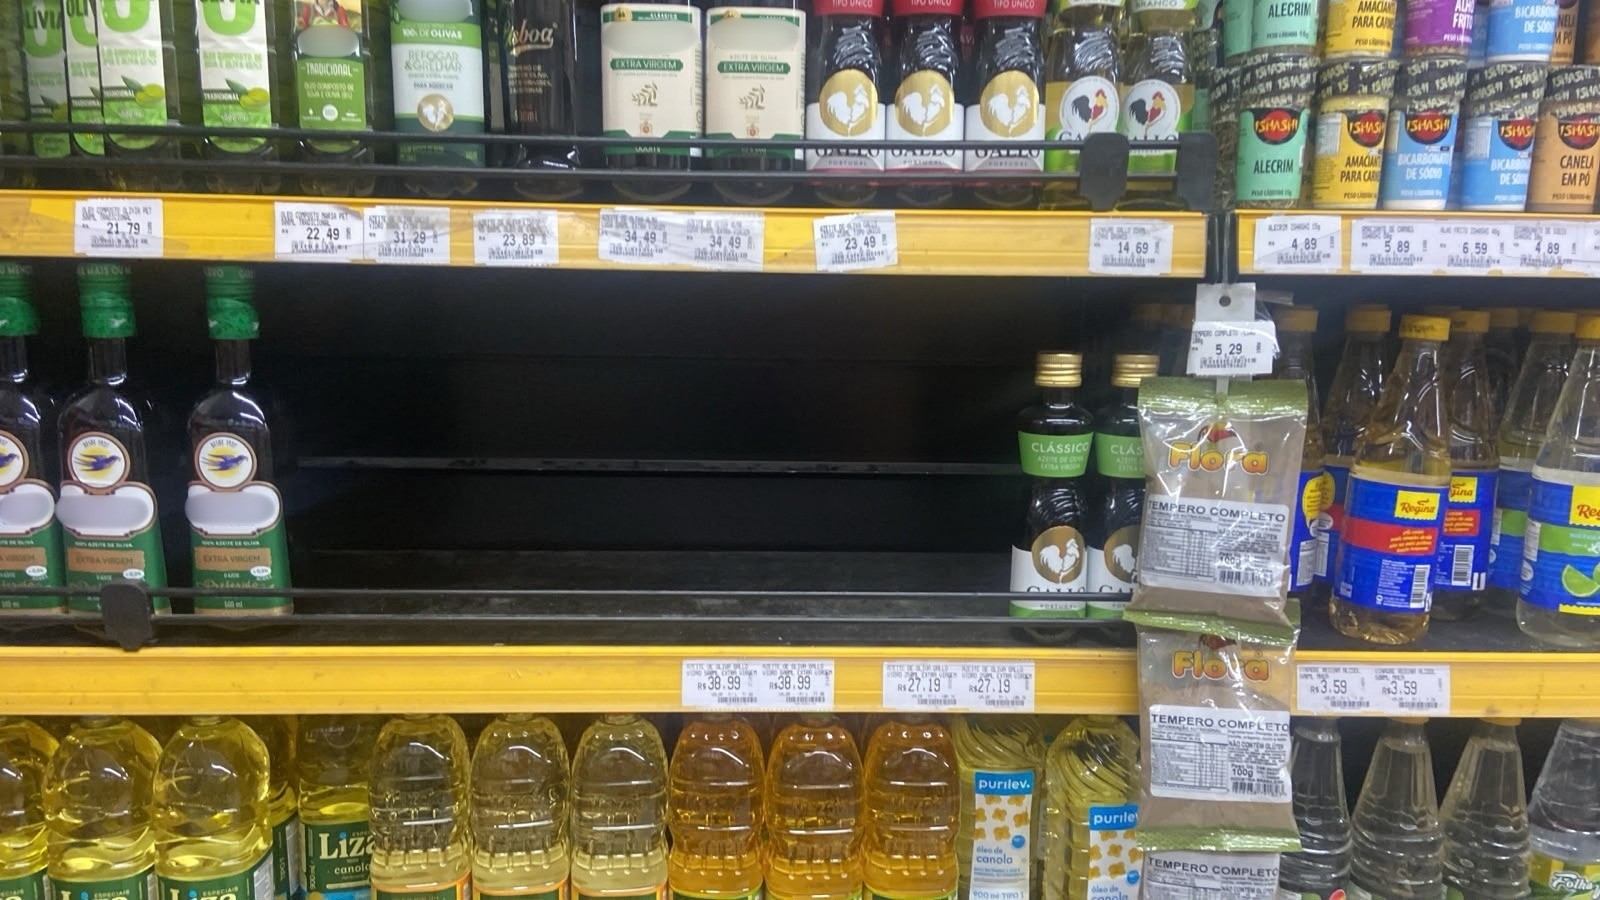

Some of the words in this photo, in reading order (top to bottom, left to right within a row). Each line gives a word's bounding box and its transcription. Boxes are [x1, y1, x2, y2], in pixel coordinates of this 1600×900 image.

[1268, 4, 1311, 18] ALECRIM
[1352, 16, 1374, 28] PARA
[431, 29, 463, 40] OLIVAS
[305, 62, 353, 77] TRADICIONAL
[616, 60, 642, 69] EXTRA
[644, 60, 677, 70] VIRGEM
[723, 63, 750, 72] EXTRA
[752, 63, 785, 73] VIRGEM
[1254, 159, 1294, 174] ALECRIM
[1560, 155, 1594, 169] CANELA
[1340, 170, 1361, 183] PARA
[1406, 168, 1418, 180] DE
[1561, 173, 1576, 186] EM
[1031, 441, 1089, 453] CLÁSSICO
[1168, 441, 1269, 475] Flora
[1400, 498, 1436, 516] Regina
[1210, 507, 1286, 523] COMPLETO
[102, 555, 134, 564] VIRGEM
[203, 555, 229, 563] EXTRA
[231, 554, 261, 563] VIRGEM
[1172, 650, 1270, 682] Flora
[1152, 713, 1214, 728] TEMPERO
[1218, 718, 1290, 733] COMPLETO
[1232, 768, 1254, 778] 100g
[976, 846, 993, 854] óleo
[994, 846, 1004, 855] de
[976, 854, 1014, 865] canola
[1148, 857, 1209, 874] TEMPERO
[1212, 865, 1279, 877] COMPLETO
[1110, 885, 1119, 894] de
